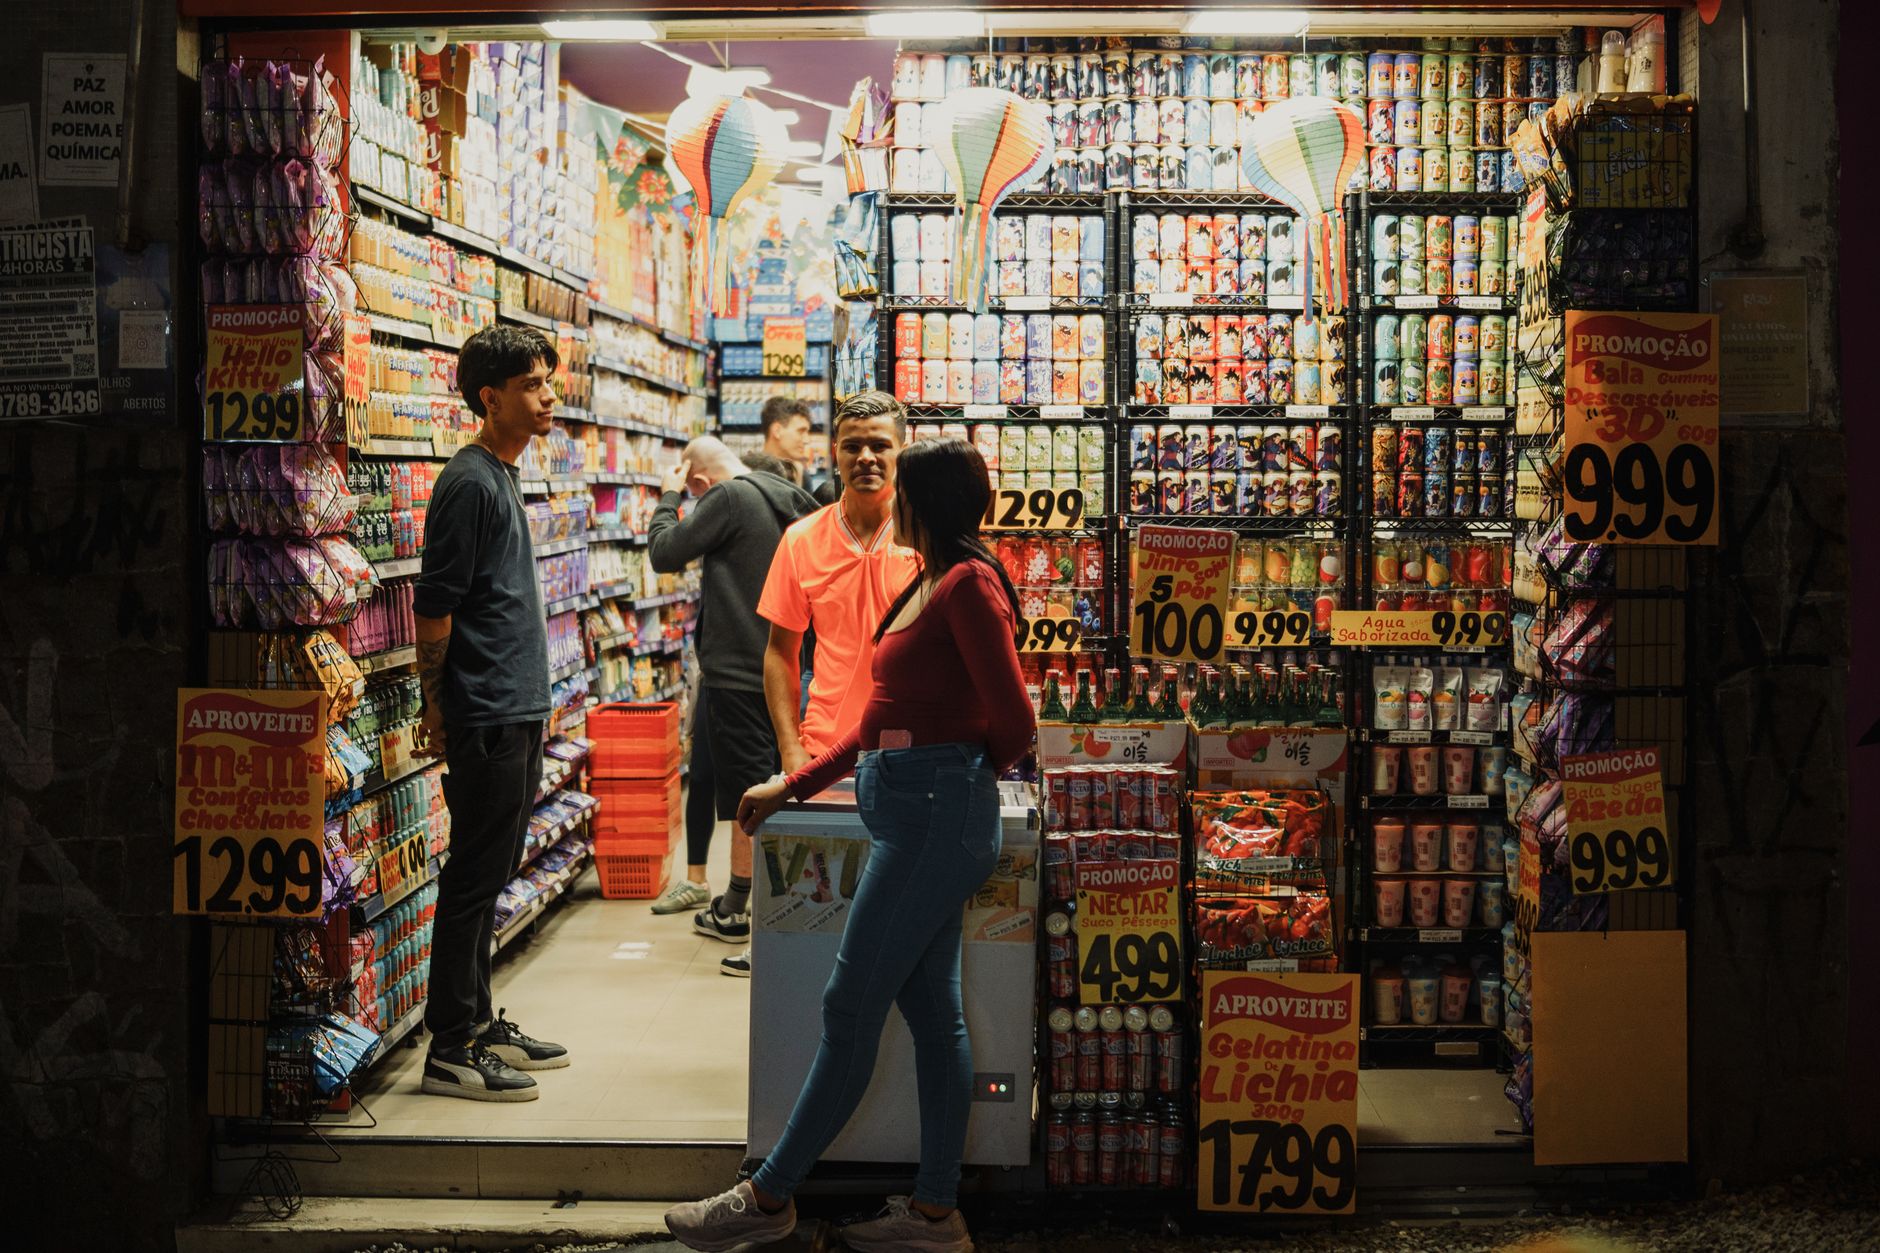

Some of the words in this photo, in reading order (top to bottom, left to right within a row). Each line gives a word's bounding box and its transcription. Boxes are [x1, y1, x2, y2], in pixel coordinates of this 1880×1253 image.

[73, 78, 106, 93] PAZ
[62, 100, 115, 115] AMOR
[51, 122, 112, 138] POEMA
[115, 123, 123, 138] E
[47, 142, 121, 161] QUÍMICA
[0, 260, 64, 275] 4HORAS
[212, 308, 300, 327] PROMOÇÃO
[765, 327, 804, 341] Oreo
[1722, 333, 1803, 342] ONTRATANDO
[221, 345, 294, 367] Hello
[1575, 333, 1709, 361] PROMOÇÃO
[348, 355, 367, 378] Hello
[1584, 359, 1645, 385] Bala
[1657, 372, 1718, 386] Gummy
[13, 384, 27, 392] NO
[28, 382, 73, 393] WhatsApp!
[100, 376, 131, 388] OLHOS
[207, 366, 281, 394] Kitty
[345, 376, 364, 401] Kitty
[123, 397, 166, 410] ABERTOS
[1565, 387, 1719, 408] Descascáveis
[207, 391, 300, 440] 12.99
[1677, 425, 1718, 445] 60g
[1564, 442, 1715, 542] 9.99
[1142, 532, 1228, 552] PROMOÇÃO
[1139, 552, 1200, 573] Jinro
[1149, 574, 1174, 603] 5
[1174, 580, 1217, 600] Por
[1135, 600, 1224, 661] 100
[1234, 611, 1310, 645] 9,99
[1338, 628, 1431, 643] Saborizada
[1362, 616, 1406, 629] Agua
[1431, 611, 1506, 645] 9,99
[187, 708, 315, 734] APROVEITE
[1284, 742, 1311, 766] 이슬
[1564, 750, 1657, 780] PROMOÇÃO
[188, 786, 311, 807] Confeitos
[1566, 785, 1605, 801] Bala
[1611, 778, 1663, 798] Super
[179, 808, 313, 830] Chocolate
[1566, 796, 1664, 824] Azeda
[1571, 827, 1670, 892] 9.99
[173, 835, 322, 914] 12.99
[1079, 863, 1174, 887] PROMOÇÃO
[1214, 874, 1241, 883] FRUIT
[1270, 871, 1298, 879] FRUIT
[1081, 917, 1114, 928] Suco
[1121, 916, 1177, 929] Pêssego
[1271, 936, 1326, 956] Lychee
[1080, 931, 1180, 1003] 4.99
[1213, 994, 1347, 1020] APROVEITE
[1207, 1032, 1356, 1061] Gelatina
[1201, 1061, 1358, 1103] Lichia
[1251, 1103, 1305, 1123] 300g
[1199, 1119, 1356, 1212] 17,99
